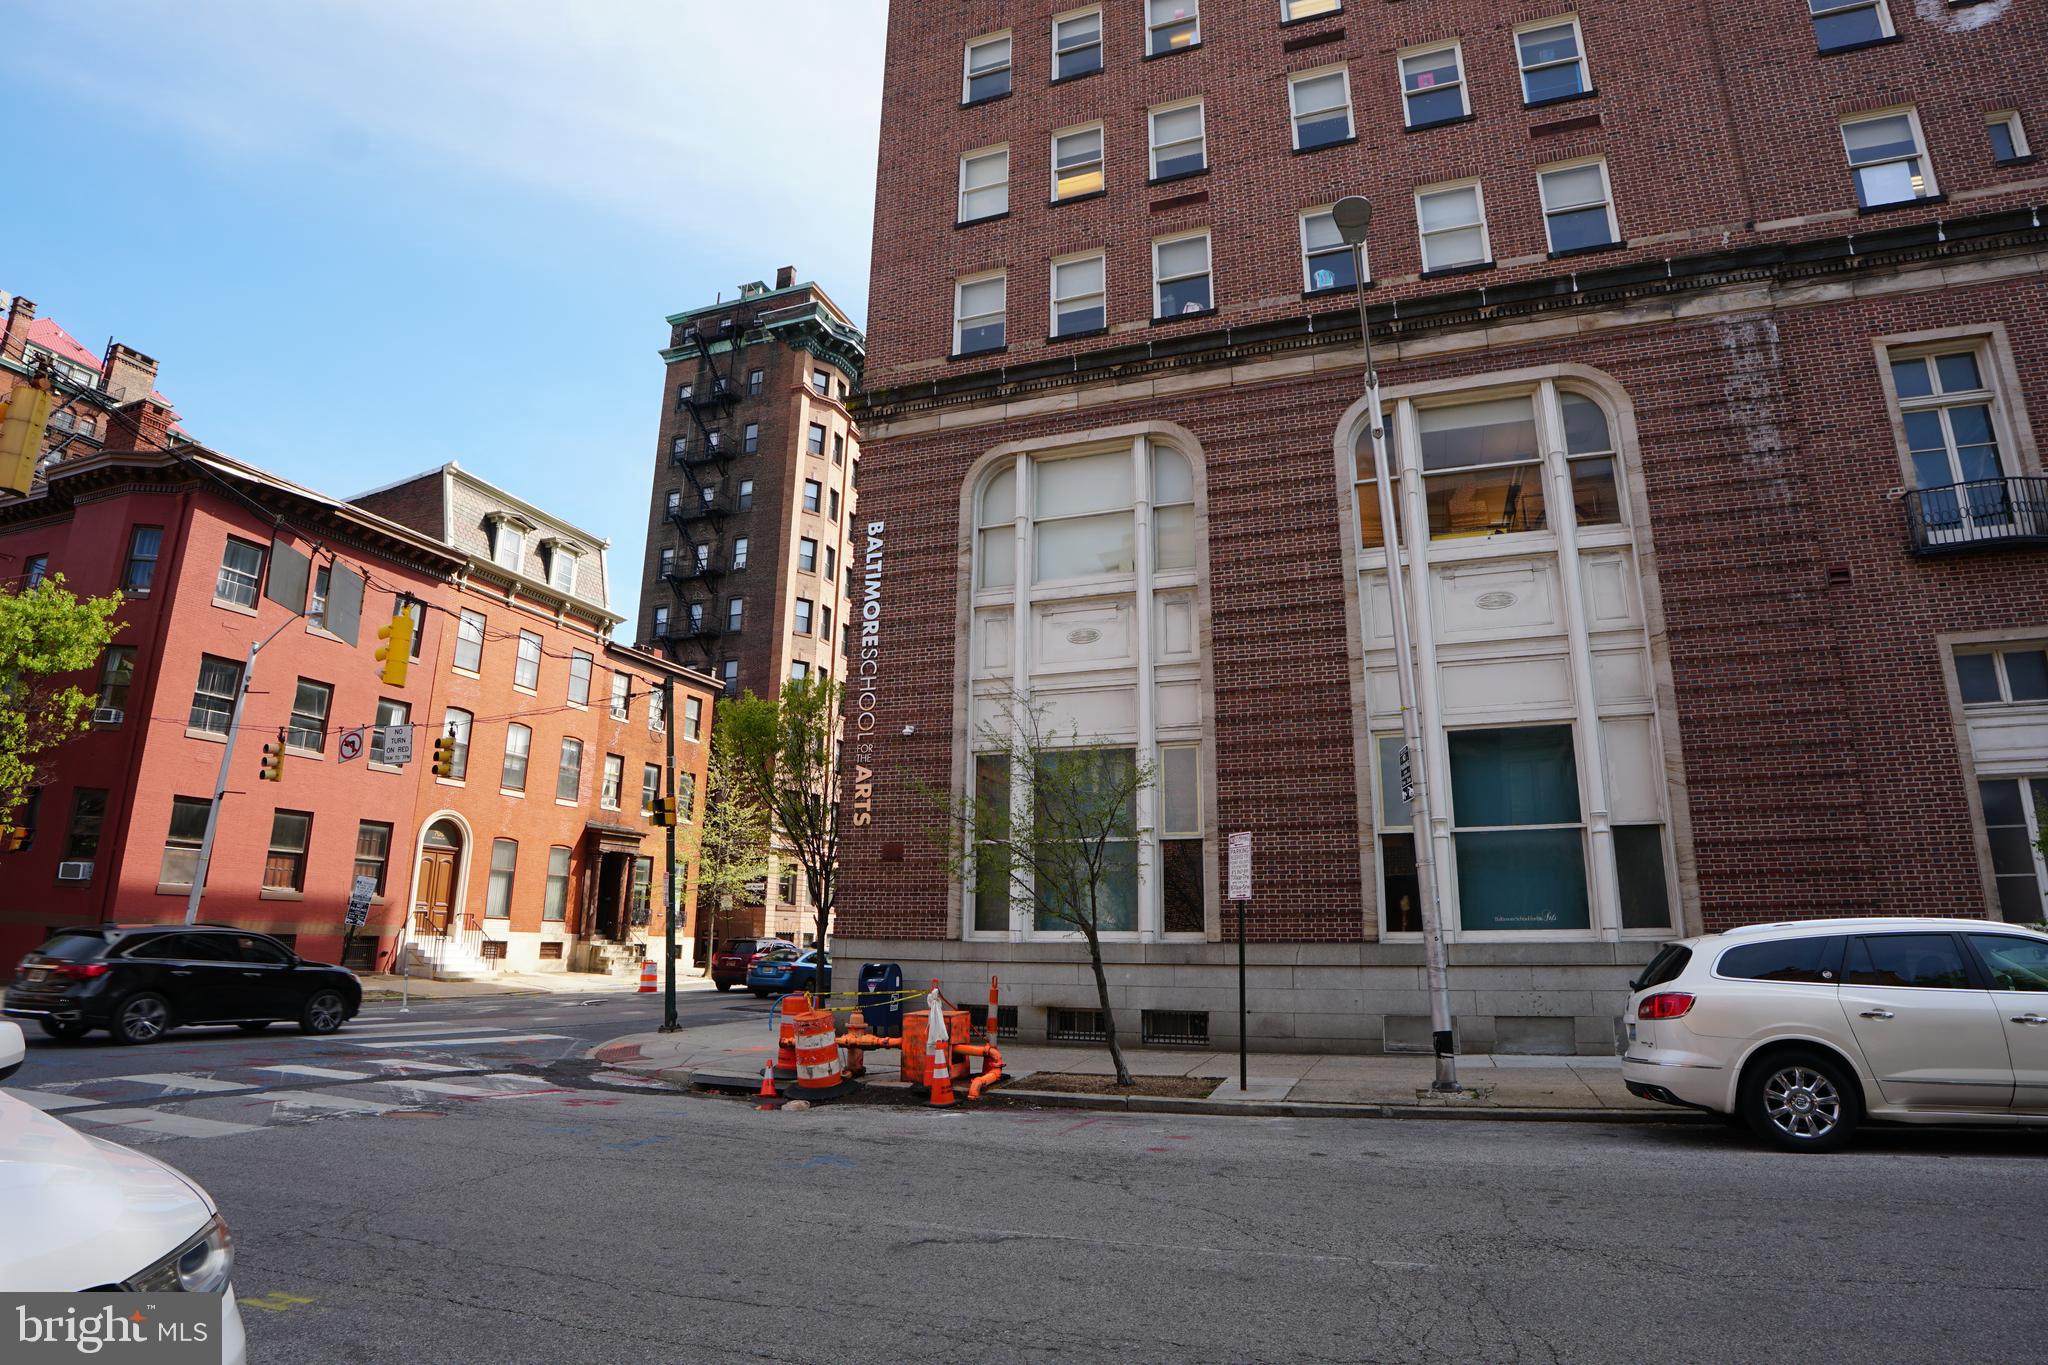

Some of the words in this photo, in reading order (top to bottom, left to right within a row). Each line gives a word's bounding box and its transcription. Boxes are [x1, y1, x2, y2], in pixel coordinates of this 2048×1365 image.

[391, 737, 407, 745] TURN
[856, 743, 874, 753] FOR
[856, 753, 872, 764] THE
[852, 764, 873, 827] ARTS
